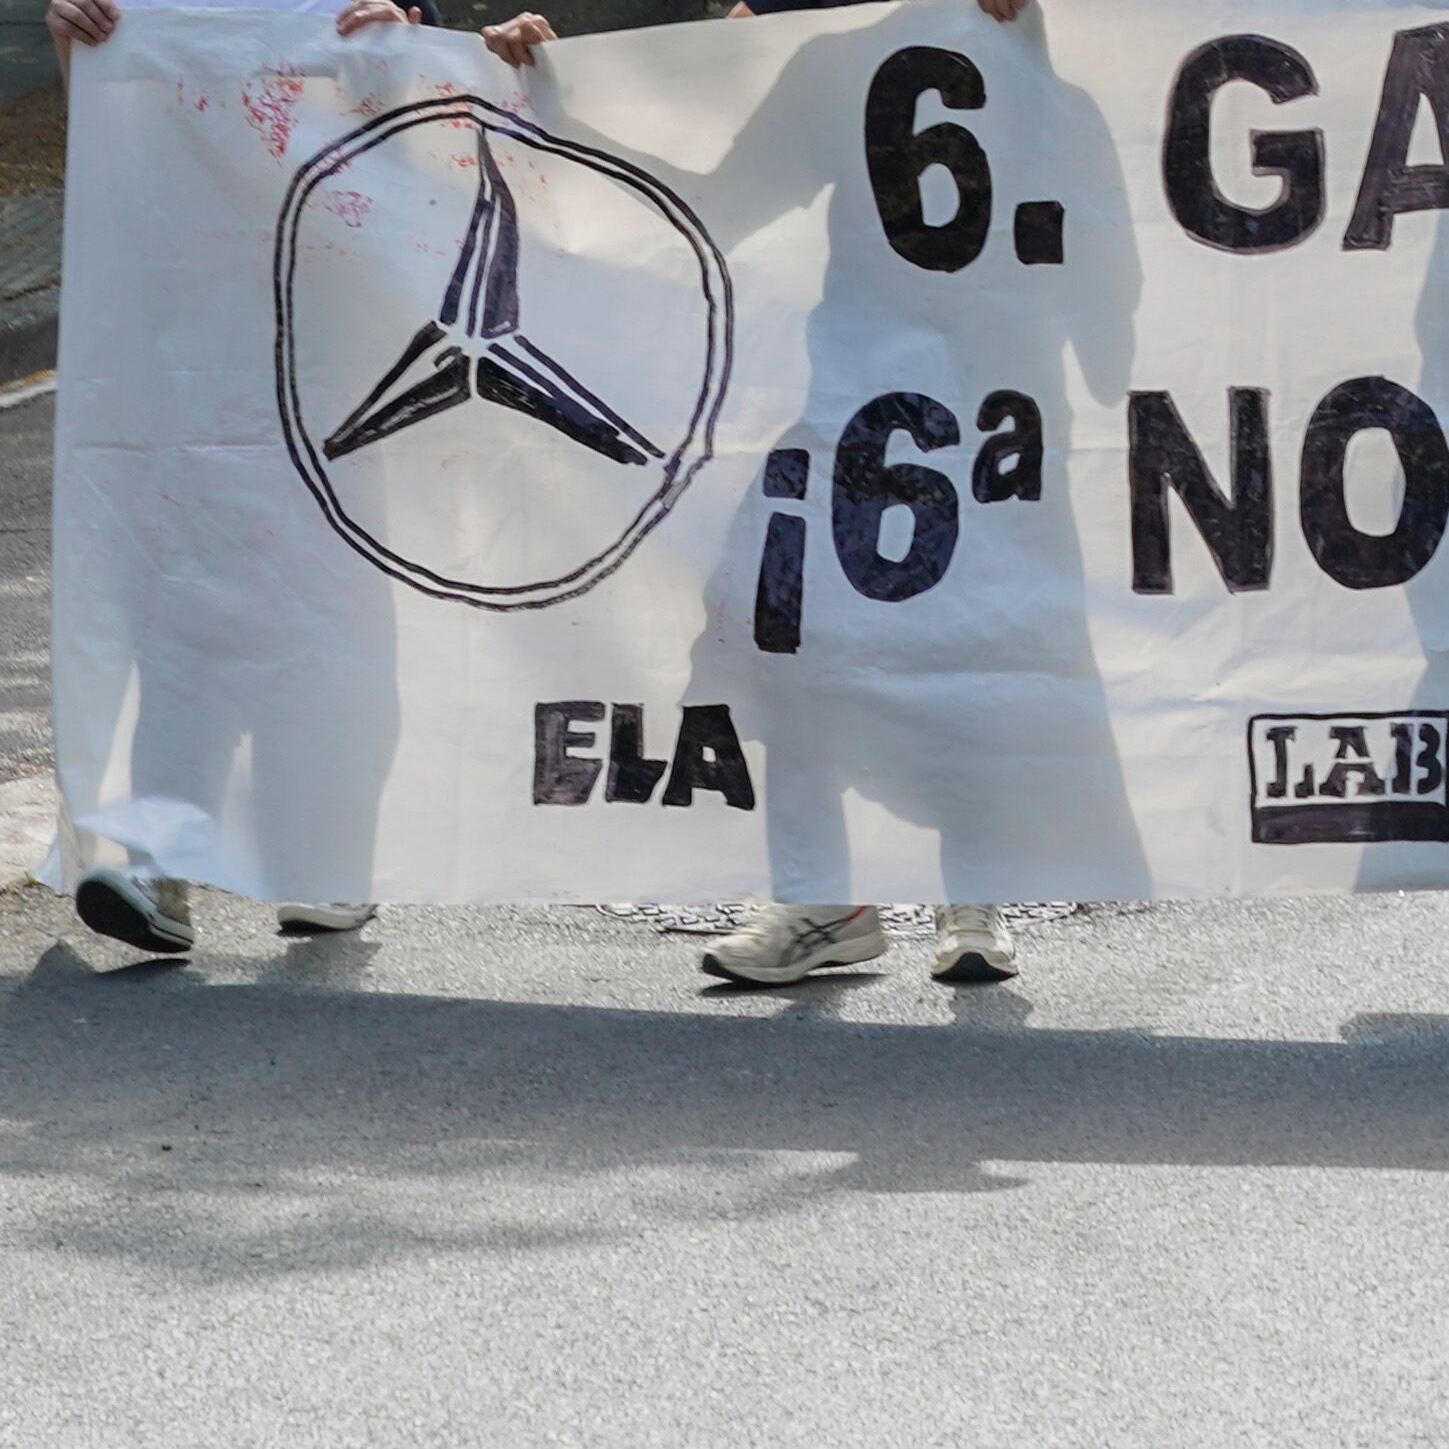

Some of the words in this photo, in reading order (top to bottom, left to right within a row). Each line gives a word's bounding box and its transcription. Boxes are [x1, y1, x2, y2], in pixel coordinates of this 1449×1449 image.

[864, 45, 1065, 272] 6.
[752, 388, 1043, 654] ¡6ª
[532, 700, 758, 811] ELA
[1264, 723, 1445, 799] LAB
